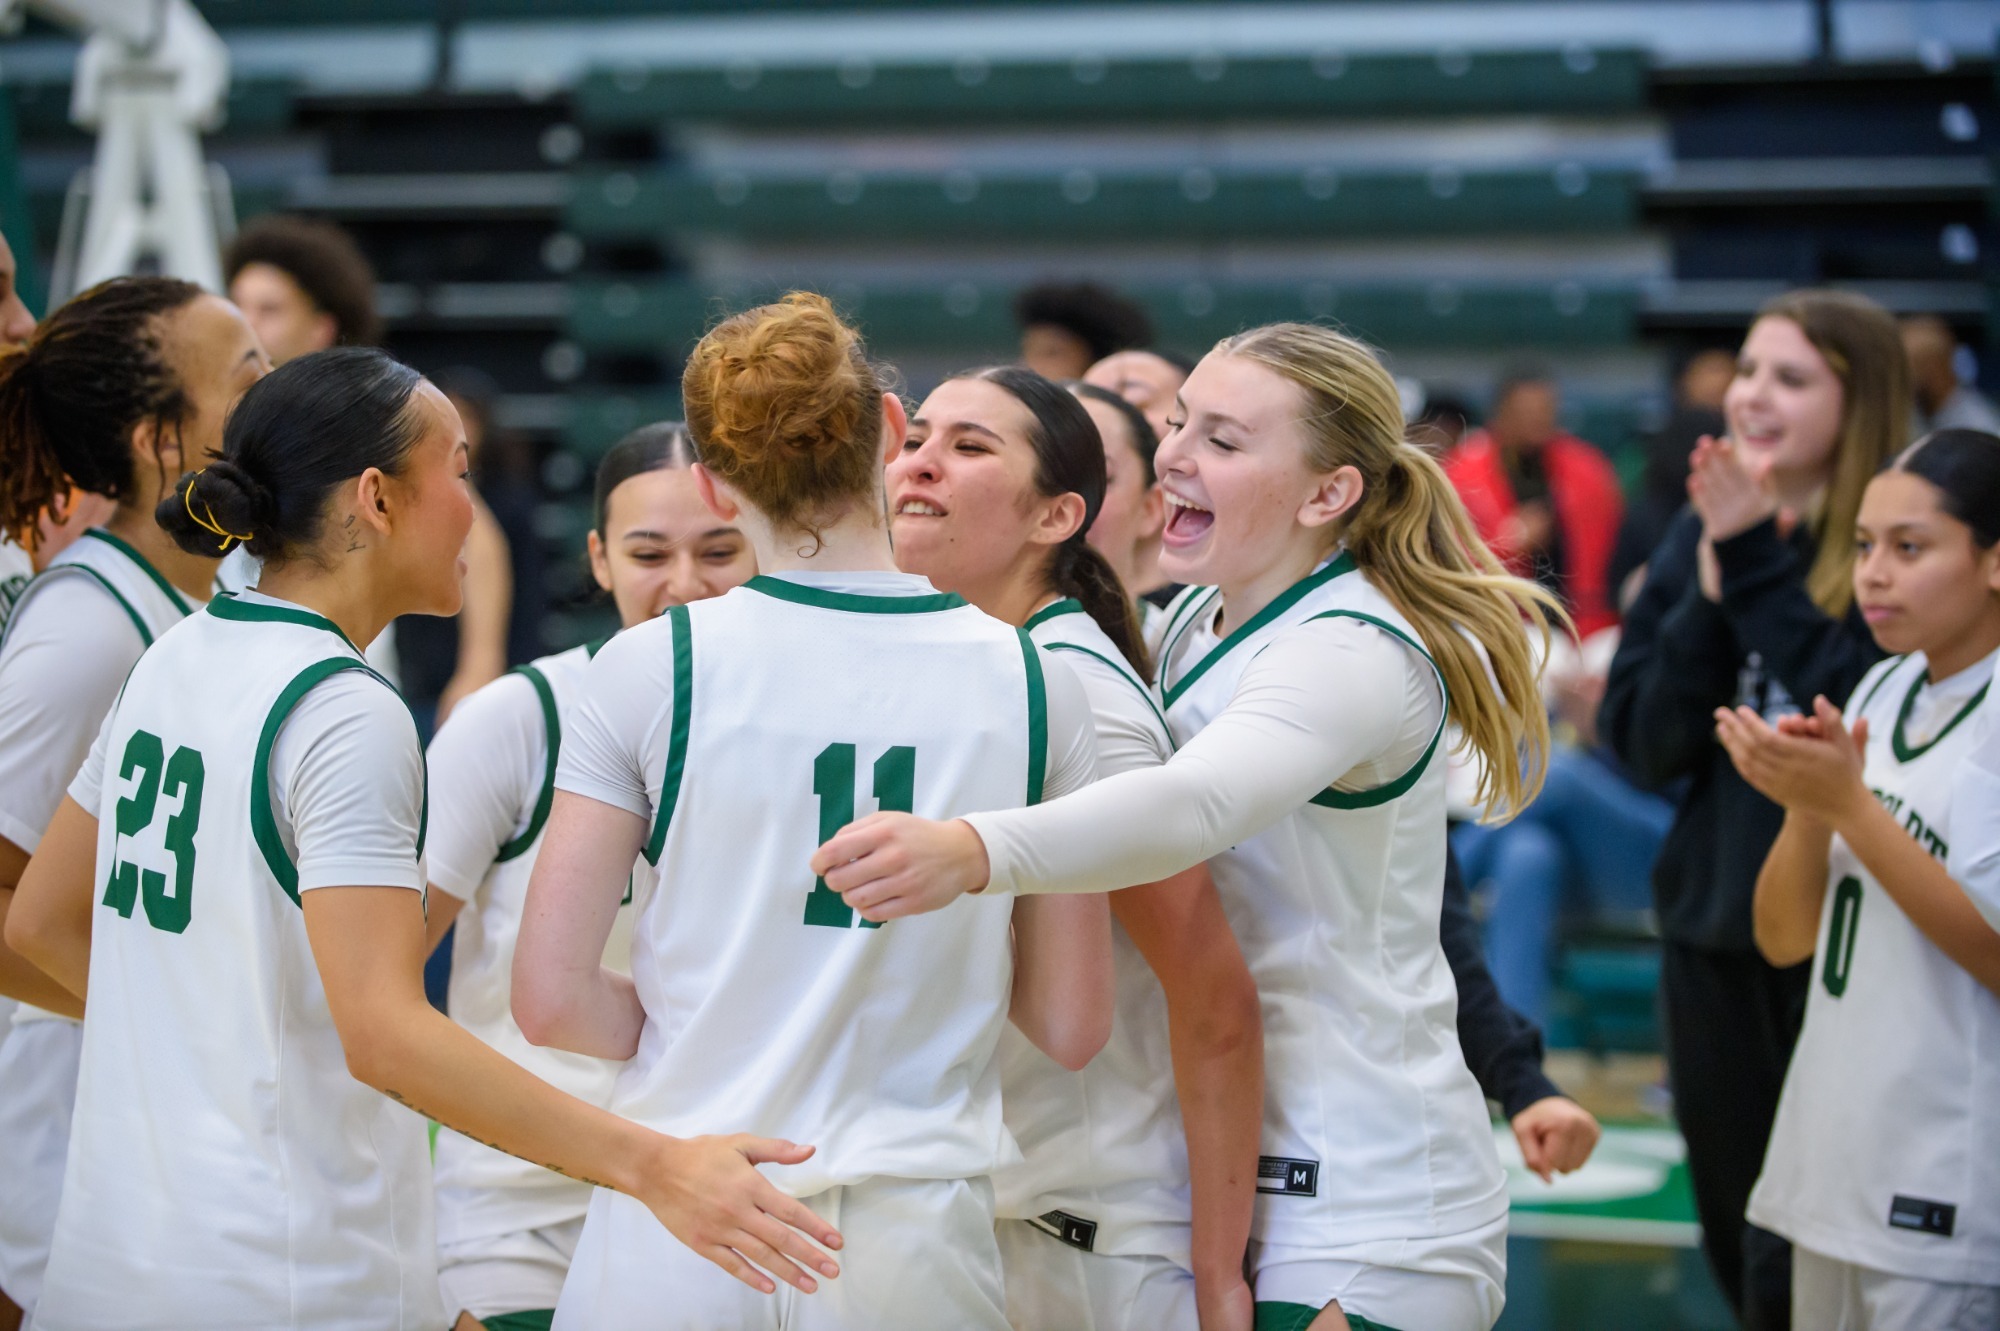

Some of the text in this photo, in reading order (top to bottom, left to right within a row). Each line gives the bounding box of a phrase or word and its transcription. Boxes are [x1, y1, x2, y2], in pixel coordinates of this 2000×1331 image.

[102, 729, 205, 934] 23
[1822, 875, 1864, 998] 0
[1293, 1170, 1307, 1185] M
[1071, 1228, 1081, 1242] L
